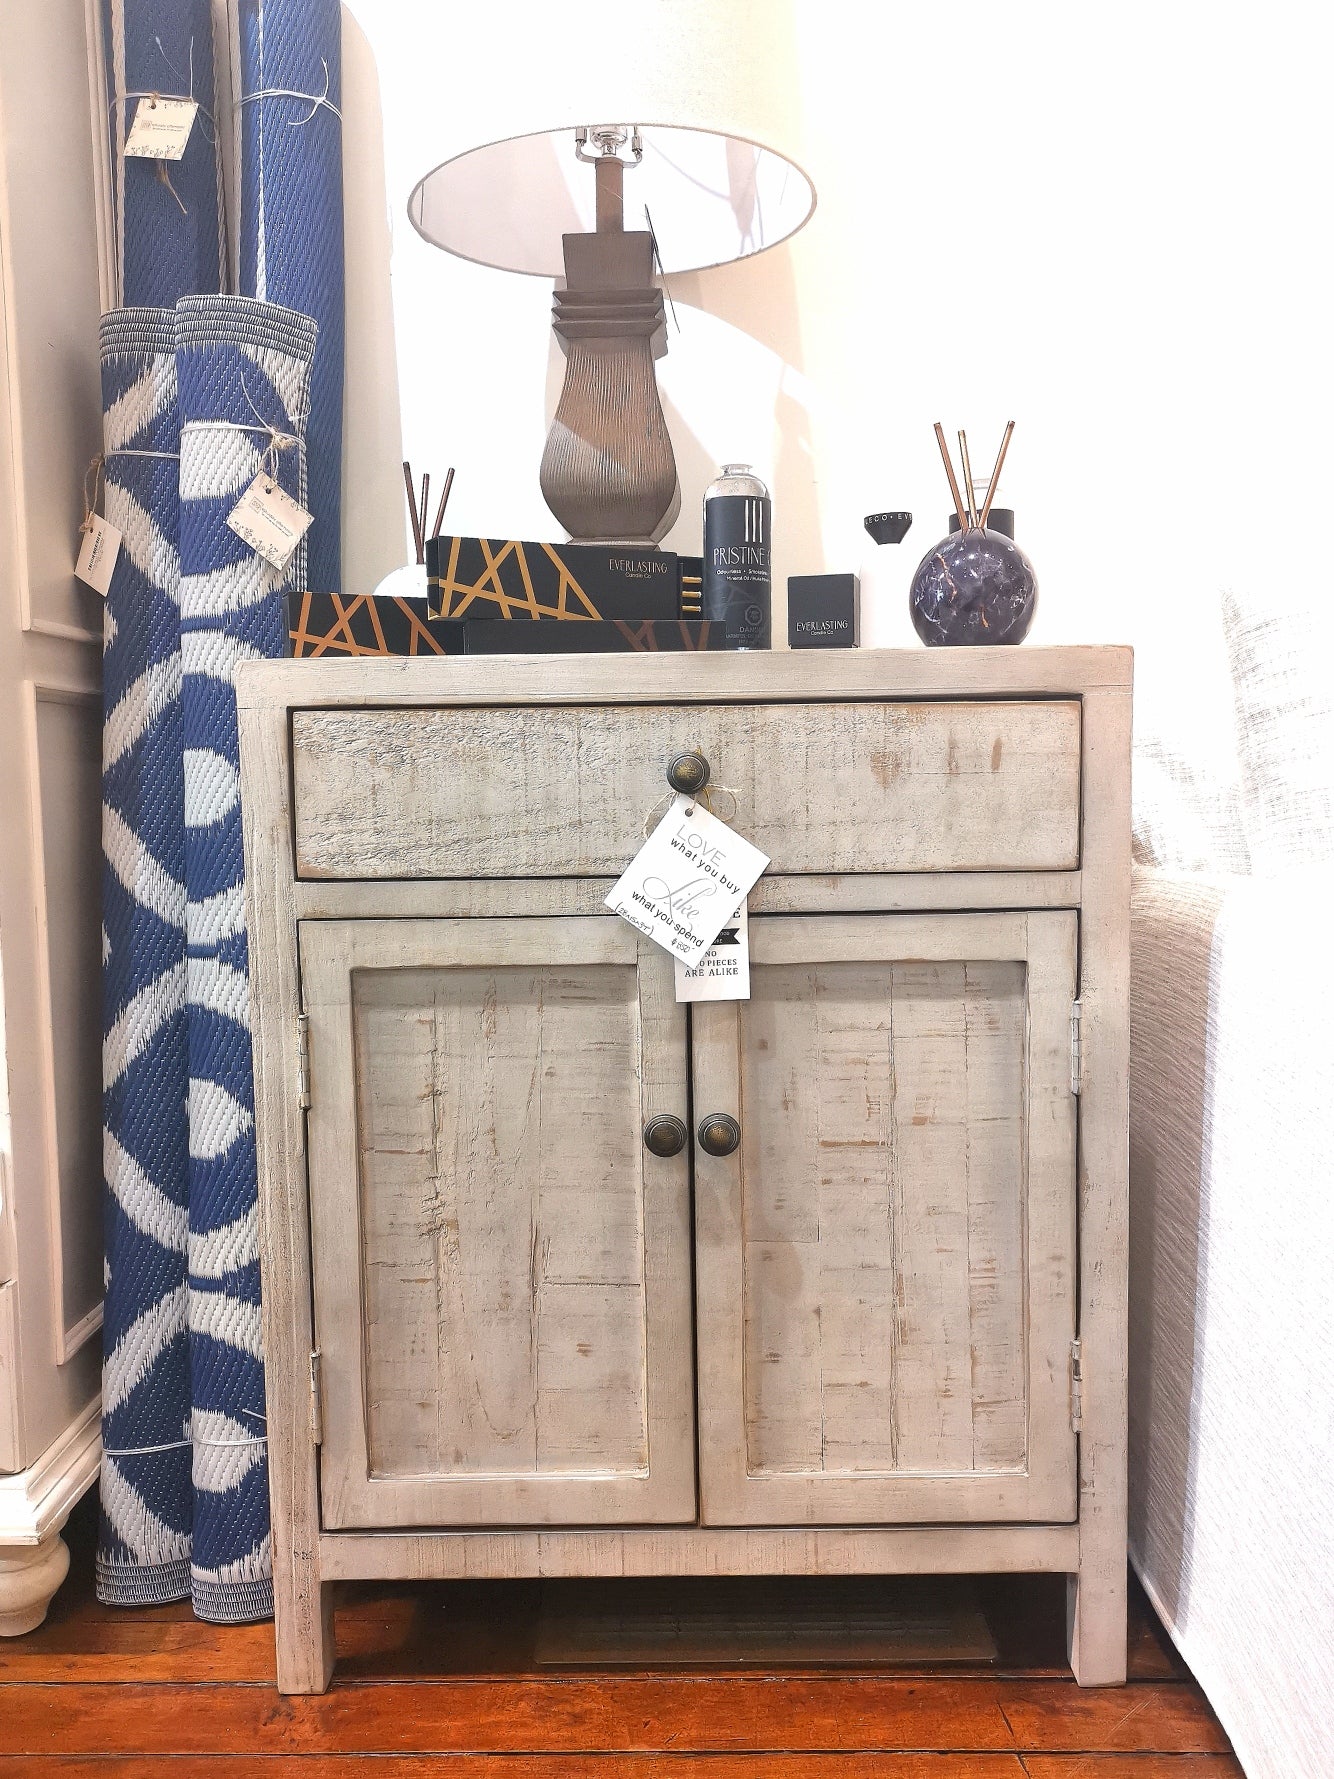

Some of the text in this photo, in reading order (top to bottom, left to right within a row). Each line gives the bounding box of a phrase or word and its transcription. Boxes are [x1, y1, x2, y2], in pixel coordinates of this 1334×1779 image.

[868, 514, 888, 524] ECO
[713, 546, 766, 566] PRISTINE
[609, 558, 668, 574] EVERLASTING
[796, 620, 848, 632] EVERLASTING
[676, 824, 727, 867] LOVE
[670, 838, 741, 895] what you buy
[631, 890, 705, 948] what you spend
[707, 958, 738, 967] PIECES
[684, 967, 739, 978] ARE ALIKE
